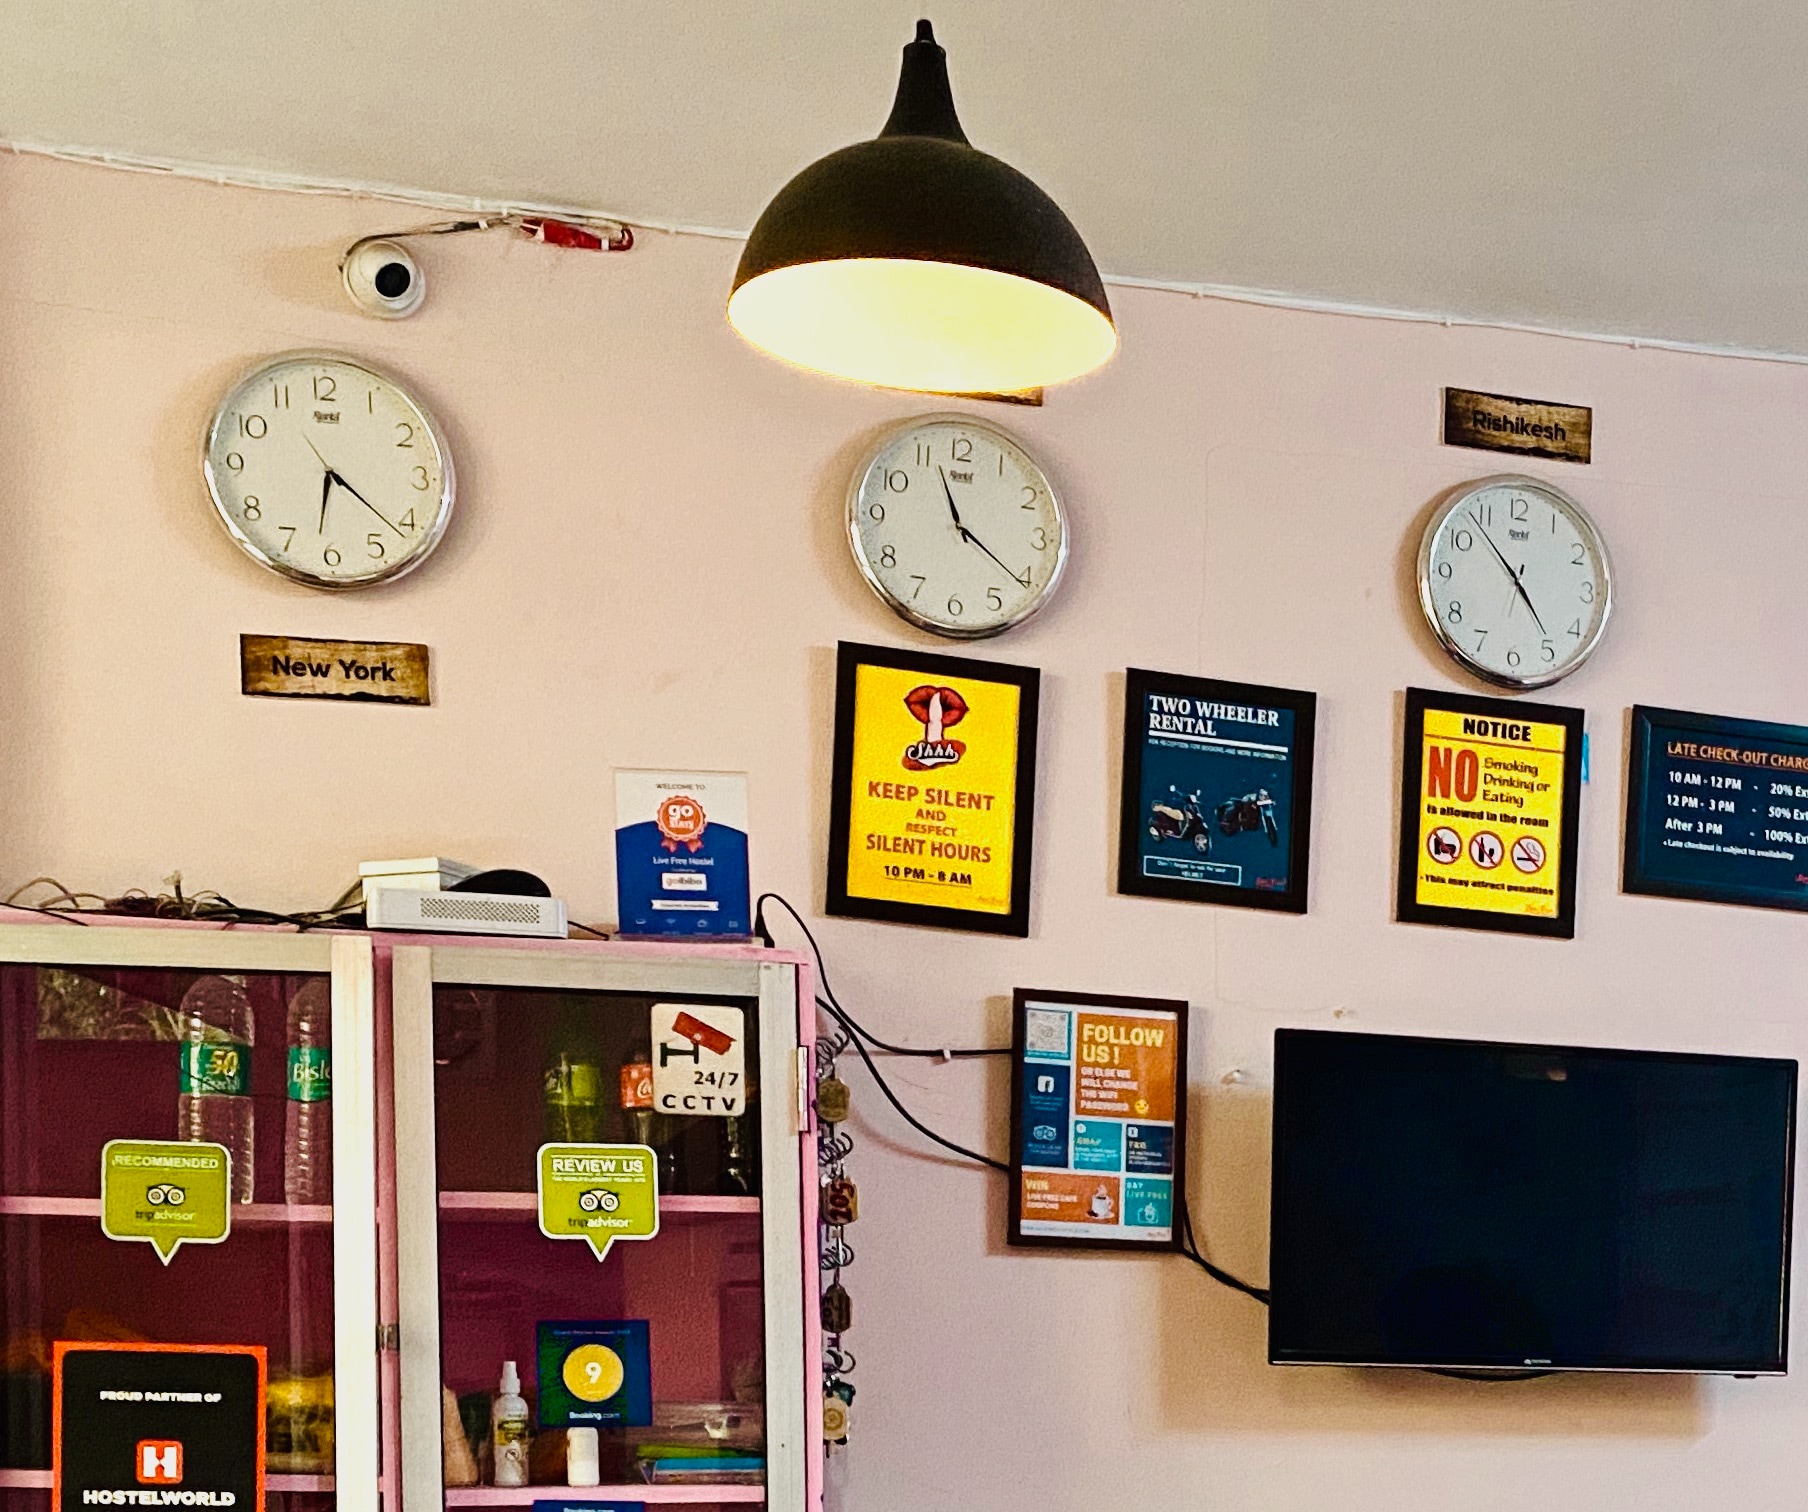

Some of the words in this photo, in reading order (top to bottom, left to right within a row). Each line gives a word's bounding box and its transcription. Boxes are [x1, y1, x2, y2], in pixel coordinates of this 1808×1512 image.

[274, 384, 289, 409] 11
[313, 376, 336, 401] 12
[239, 415, 267, 439] 10
[396, 423, 413, 447] 2
[1472, 410, 1566, 441] Rishikesh
[226, 452, 244, 475] 9
[411, 466, 429, 490] 3
[244, 496, 262, 521] 8
[399, 508, 415, 531] 4
[278, 526, 296, 552] 7
[367, 534, 384, 559] 5
[324, 543, 341, 567] 6
[271, 655, 330, 679] New
[338, 659, 396, 682] York
[1149, 694, 1191, 714] TWO
[1195, 701, 1279, 726] WHEELER
[1149, 713, 1217, 736] RENTAL
[1463, 717, 1531, 742] NOTICE
[907, 743, 958, 765] Shhh
[1668, 741, 1697, 757] LATE
[1700, 745, 1768, 765] CHECK-OUT
[1428, 746, 1479, 802] NO
[1484, 757, 1538, 777] Smoking
[1484, 773, 1534, 793] Drinking
[1536, 783, 1550, 791] or
[1669, 771, 1681, 783] 10
[1684, 773, 1701, 785] AM
[1711, 776, 1723, 788] 12
[1725, 778, 1741, 790] PM
[1770, 783, 1793, 796] 20%
[868, 781, 918, 802] KEEP
[925, 788, 995, 811] SILENT
[1483, 789, 1523, 808] Eating
[1667, 795, 1679, 807] 12
[1682, 796, 1698, 809] PM
[1709, 800, 1715, 811] 3
[1718, 801, 1735, 814] PM
[1768, 806, 1791, 820] 50%
[668, 805, 694, 818] go
[916, 809, 947, 821] AND
[1440, 807, 1484, 820] allowed
[1486, 812, 1497, 821] in
[1500, 813, 1517, 824] the
[1520, 817, 1548, 827] room
[906, 823, 957, 837] RESPECT
[1665, 818, 1692, 832] After
[1697, 822, 1703, 832] 3
[1705, 822, 1723, 835] PM
[1764, 830, 1793, 843] 100%
[866, 834, 925, 855] SILENT
[931, 842, 991, 863] HOURS
[653, 857, 669, 865] Live
[670, 857, 687, 865] Free
[884, 865, 900, 877] 10
[904, 868, 925, 880] PM
[938, 871, 946, 882] 8
[949, 873, 972, 885] AM
[1426, 874, 1446, 883] This
[1448, 878, 1469, 887] may
[1083, 1024, 1163, 1047] FOLLOW
[1083, 1044, 1110, 1063] US
[694, 1071, 738, 1089] 24/7
[662, 1094, 736, 1111] CCTV
[112, 1154, 219, 1170] RECOMMENDED
[553, 1159, 615, 1172] REVIEW
[622, 1160, 643, 1172] US
[135, 1209, 196, 1223] tripadvisor
[568, 1216, 630, 1228] tripadvisor
[586, 1362, 601, 1384] 9
[100, 1391, 143, 1401] PROUD
[145, 1392, 202, 1402] PARTNER
[204, 1393, 222, 1403] OF
[143, 1446, 177, 1477] H
[83, 1490, 236, 1506] HOSTELWORLD
